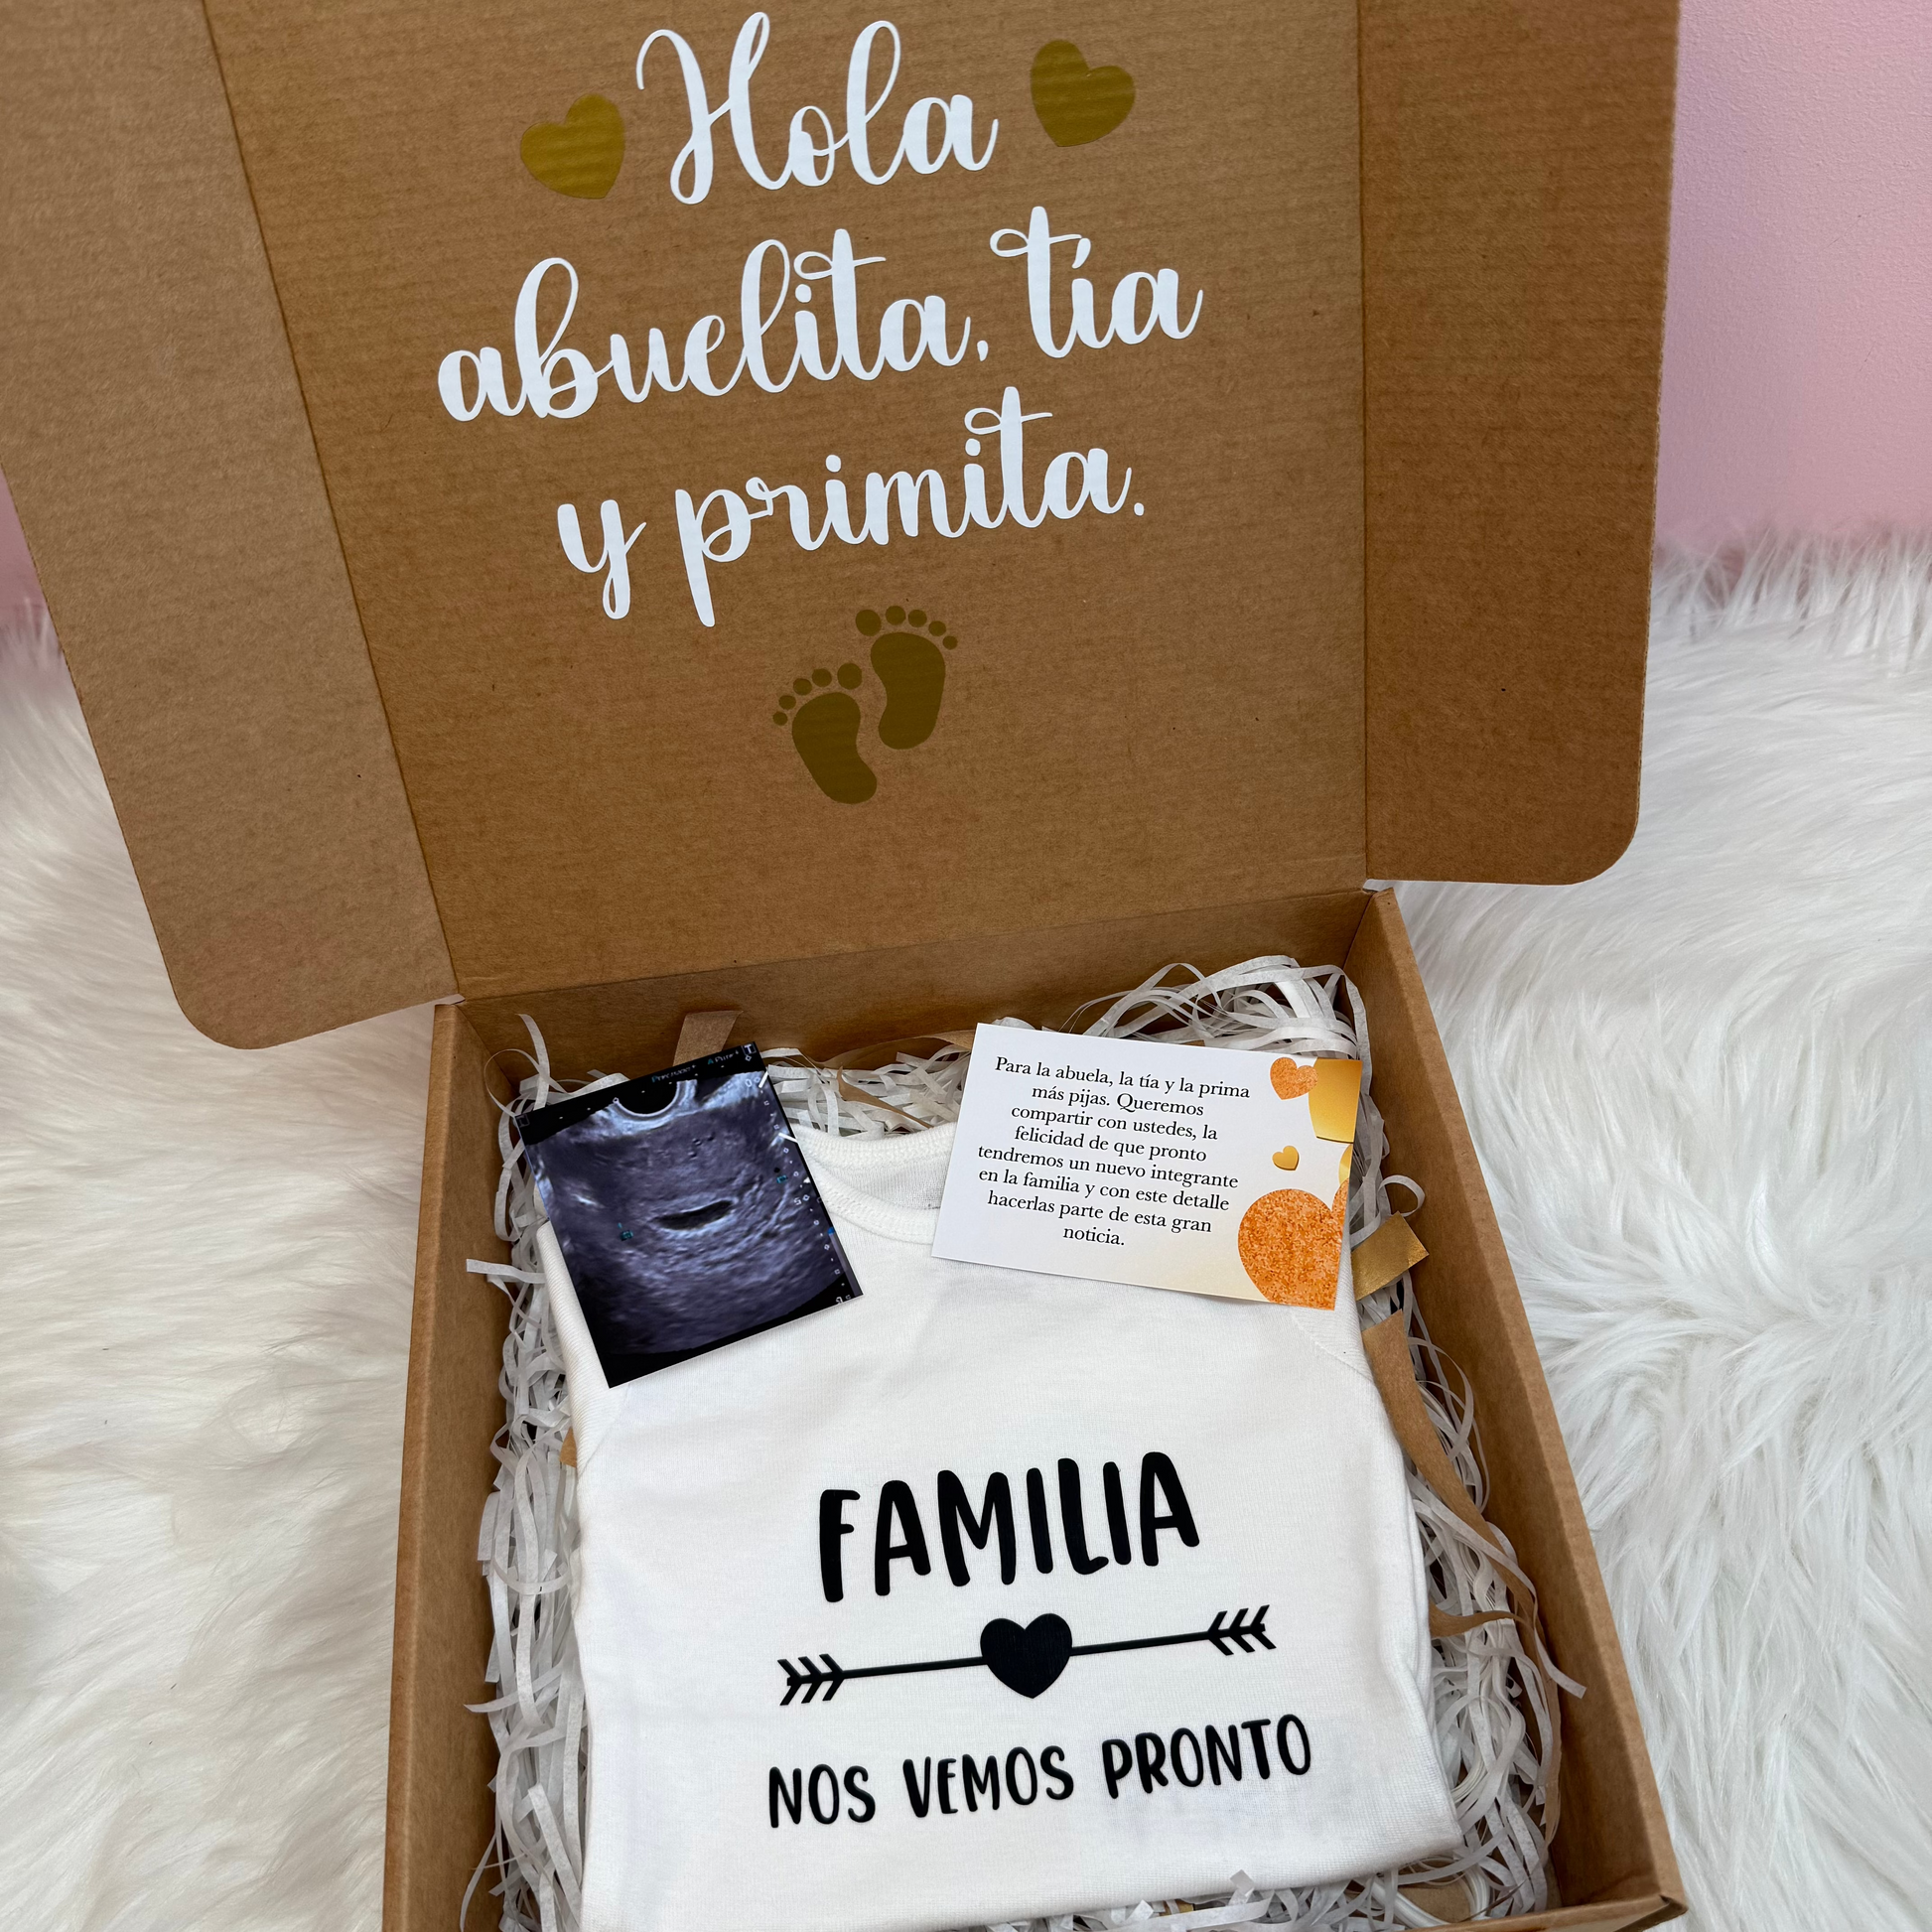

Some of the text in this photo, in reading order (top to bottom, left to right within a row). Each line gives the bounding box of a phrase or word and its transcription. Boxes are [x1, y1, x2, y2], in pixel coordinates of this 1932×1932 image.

[636, 11, 999, 205] Hola
[437, 206, 1203, 422] abuelita, tía
[557, 386, 1147, 627] y primita.
[995, 1055, 1251, 1099] Para la abuela, la tía y la prima
[1032, 1085, 1204, 1117] más pijas. Queremos
[1011, 1107, 1218, 1142] compartir con ustedes, la
[1014, 1125, 1207, 1162] felicidad de que pronto
[978, 1146, 1238, 1188] tendremos un nuevo integrante
[978, 1169, 1230, 1211] en la familia y con este detalle
[987, 1189, 1212, 1234] hacerlas parte de esta gran
[1062, 1226, 1125, 1246] noticia.
[819, 1451, 1200, 1603] FAMILIA
[768, 1714, 1311, 1829] NOS VEMOS PRONTO
